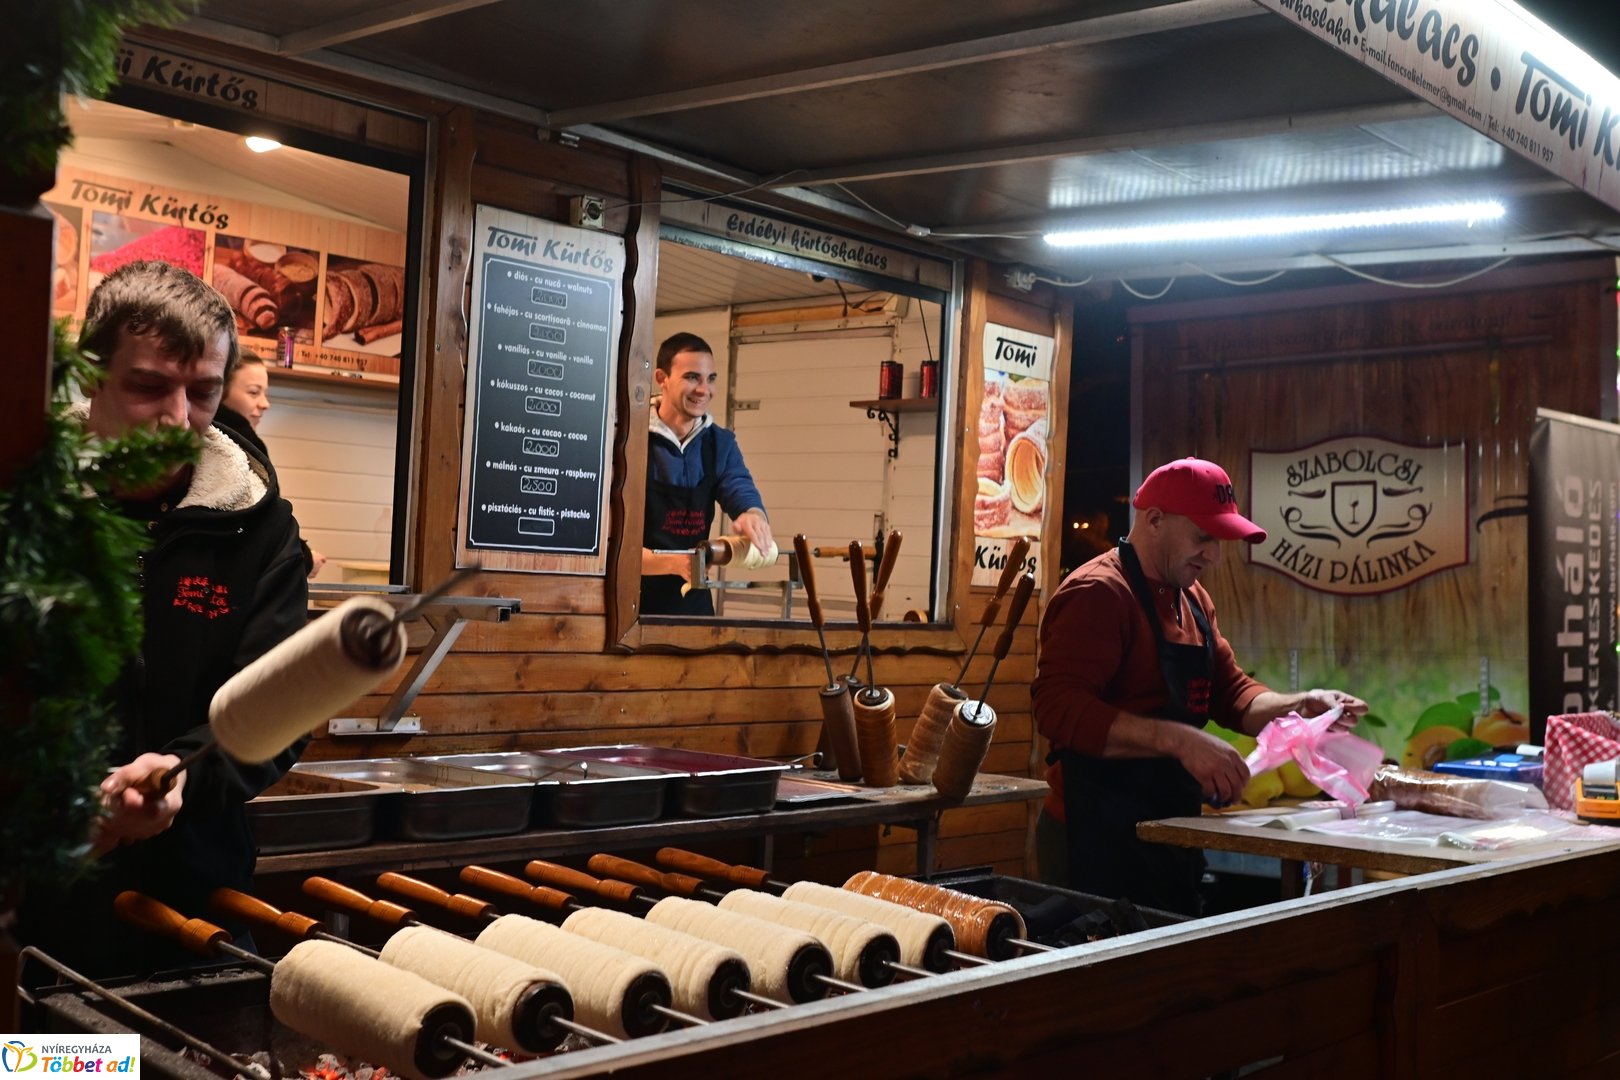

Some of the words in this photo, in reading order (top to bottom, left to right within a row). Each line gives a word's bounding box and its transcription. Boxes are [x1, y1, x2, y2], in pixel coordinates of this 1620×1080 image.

[142, 55, 259, 110] Kürtős
[1279, 0, 1351, 45] arkaslaka
[1501, 126, 1515, 141] +40
[1516, 131, 1529, 149] 740
[1529, 139, 1541, 157] 811
[1542, 147, 1554, 163] 957
[1515, 51, 1592, 151] Tomi
[1593, 105, 1620, 171] K
[71, 179, 133, 210] Tomi
[139, 193, 230, 229] Kürtős
[487, 226, 538, 257] Tomi
[543, 239, 614, 274] Kürtős
[727, 213, 788, 246] Erdélyi
[791, 230, 888, 270] kürtőskalács
[514, 270, 528, 282] diós
[535, 276, 543, 284] cu
[567, 282, 593, 295] walnuts
[525, 311, 533, 319] cu
[577, 319, 607, 332] cinnamon
[536, 349, 544, 357] cu
[573, 354, 594, 365] vanilla
[995, 336, 1037, 368] Tomi
[496, 379, 528, 392] kókuszos
[569, 391, 596, 401] coconut
[500, 422, 525, 434] kakaós
[532, 428, 540, 436] cu
[492, 460, 517, 472] málnás
[524, 465, 532, 473] cu
[565, 468, 597, 481] raspberry
[1286, 449, 1423, 487] SZABOLCSI
[538, 506, 555, 517] fistic
[561, 509, 591, 522] pistachio
[974, 545, 1037, 574] Kürs
[1270, 537, 1323, 580] HÁZI
[1329, 539, 1436, 585] PÁLINKA
[1556, 475, 1583, 714] orháló
